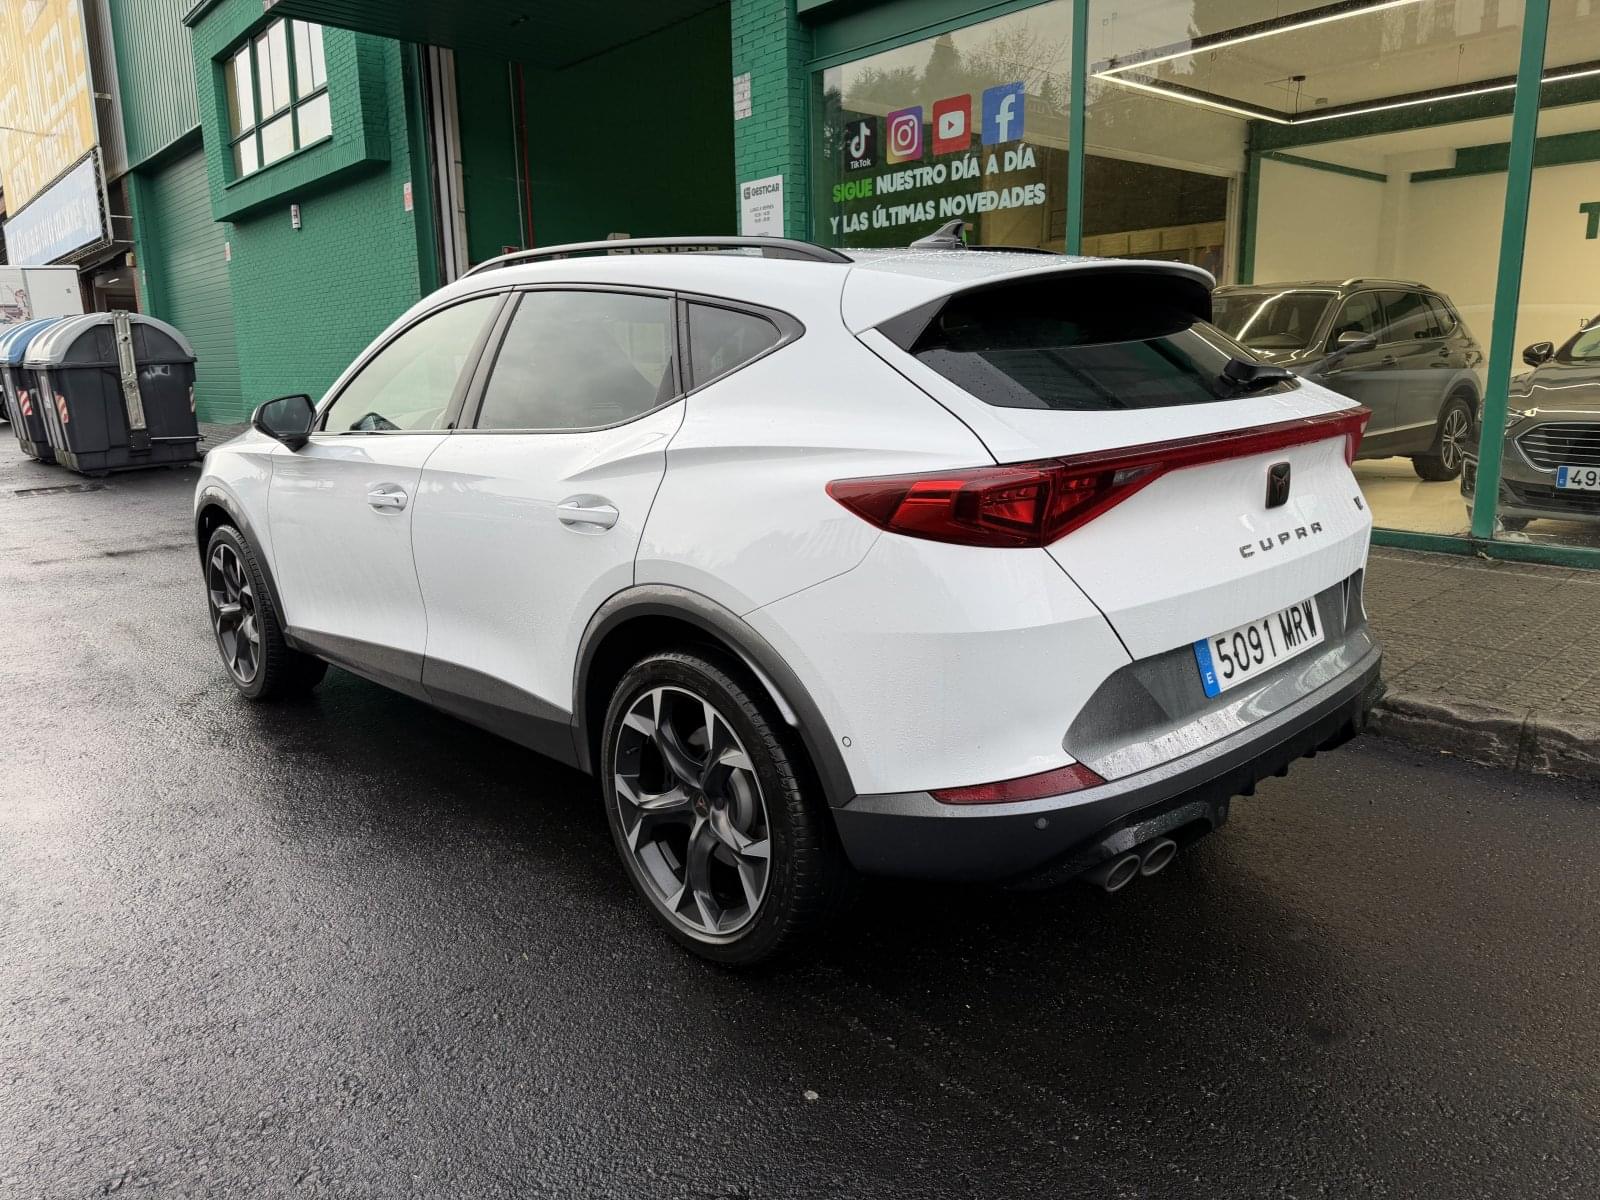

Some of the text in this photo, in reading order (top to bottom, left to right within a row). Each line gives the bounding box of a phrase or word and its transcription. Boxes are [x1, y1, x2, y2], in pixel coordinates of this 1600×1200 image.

[832, 143, 1037, 203] SIGUE NUESTRO DÍA A DÍA
[850, 158, 872, 170] TikTok
[751, 182, 780, 197] GESTICAR
[829, 182, 1046, 235] Y LAS ÚLTIMAS NOVEDADES
[1569, 469, 1600, 487] 49
[1239, 521, 1323, 559] CUPRA
[1215, 599, 1318, 679] 5091 MRW
[1206, 671, 1214, 685] E
